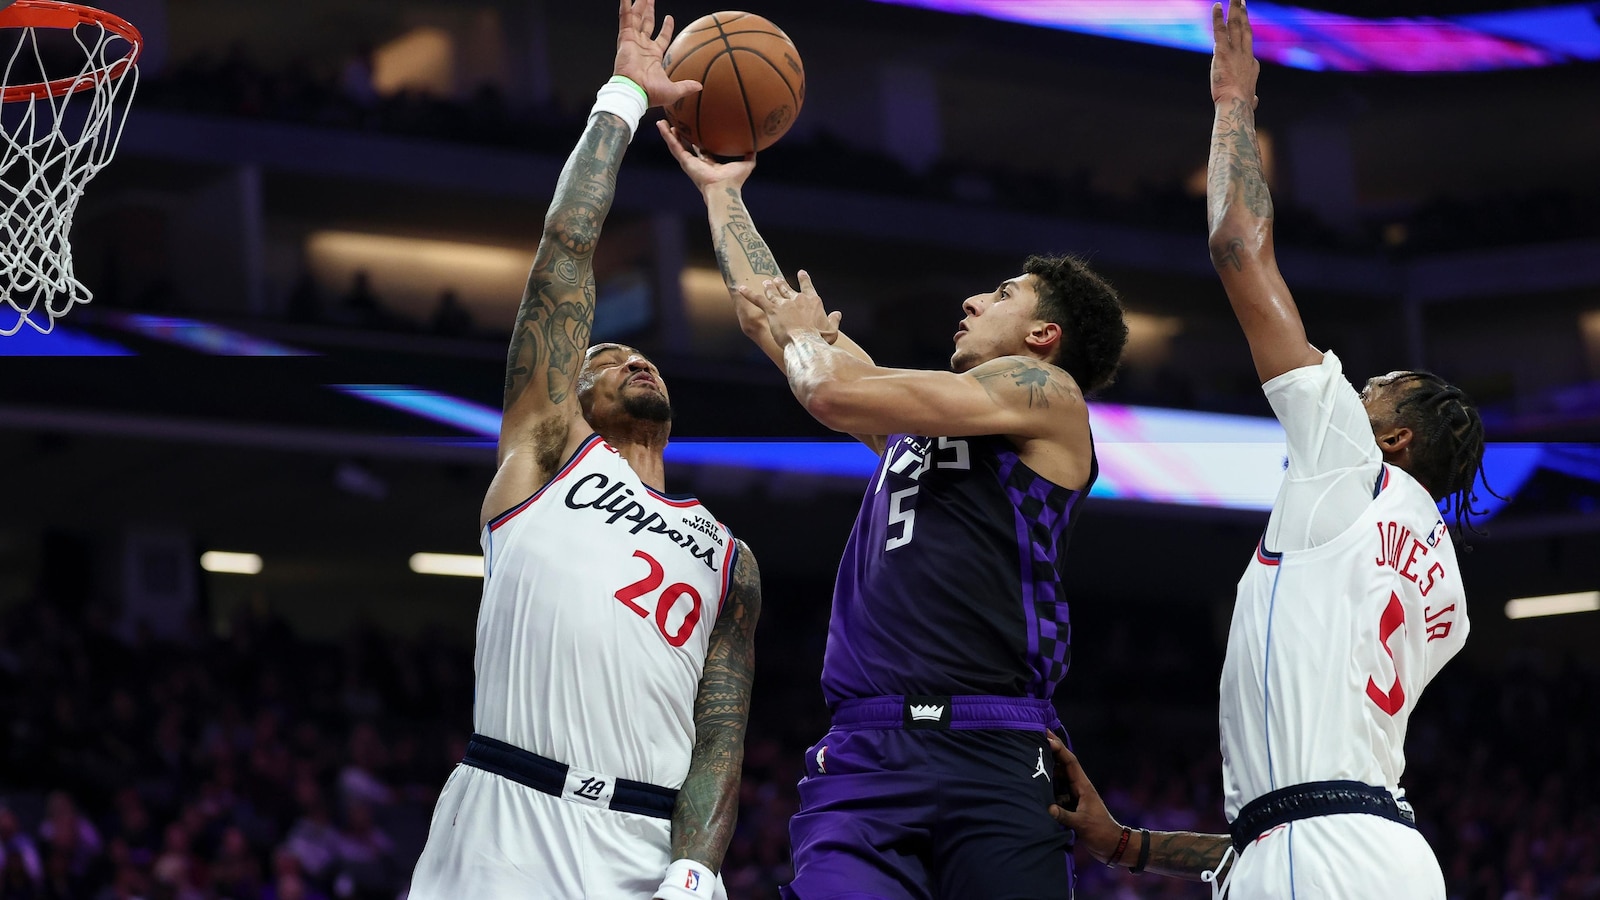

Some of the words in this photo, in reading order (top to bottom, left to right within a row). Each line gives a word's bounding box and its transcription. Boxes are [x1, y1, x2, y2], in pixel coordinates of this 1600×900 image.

[564, 473, 718, 572] Clippers
[682, 517, 723, 547] RWANDA
[694, 515, 719, 533] VISIT
[885, 485, 919, 551] 5
[1376, 521, 1445, 597] JONES
[614, 549, 702, 648] 20
[1365, 590, 1407, 717] 5
[573, 776, 605, 801] LA
